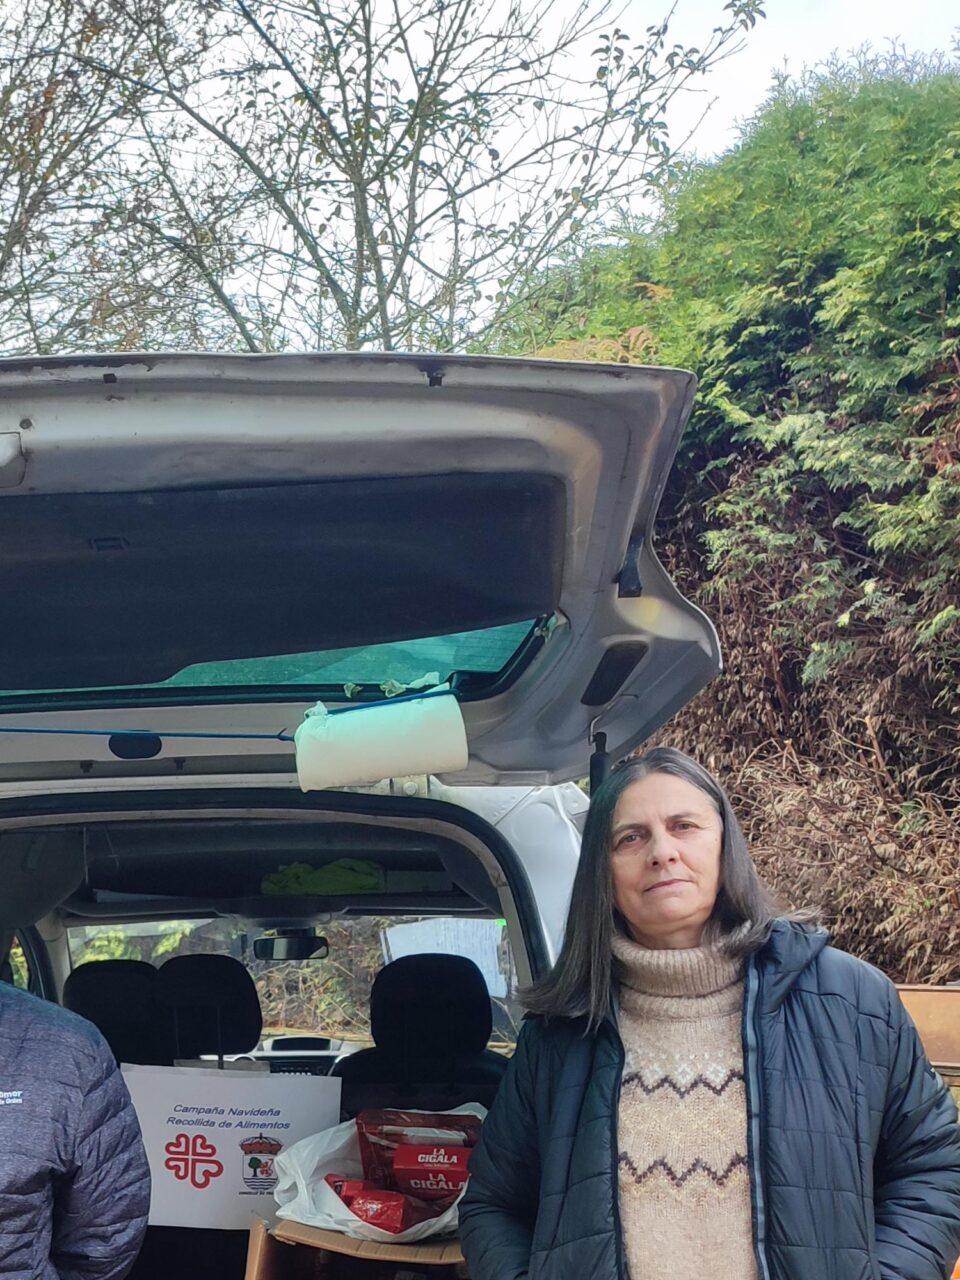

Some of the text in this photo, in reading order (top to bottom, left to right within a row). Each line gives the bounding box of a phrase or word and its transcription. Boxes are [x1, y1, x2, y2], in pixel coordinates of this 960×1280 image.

[173, 1104, 281, 1117] Campaña Navideña
[166, 1116, 291, 1129] Recollida de Alimentos
[417, 1154, 458, 1163] CIGALA
[428, 1172, 446, 1181] LA
[410, 1180, 466, 1190] CIGALA
